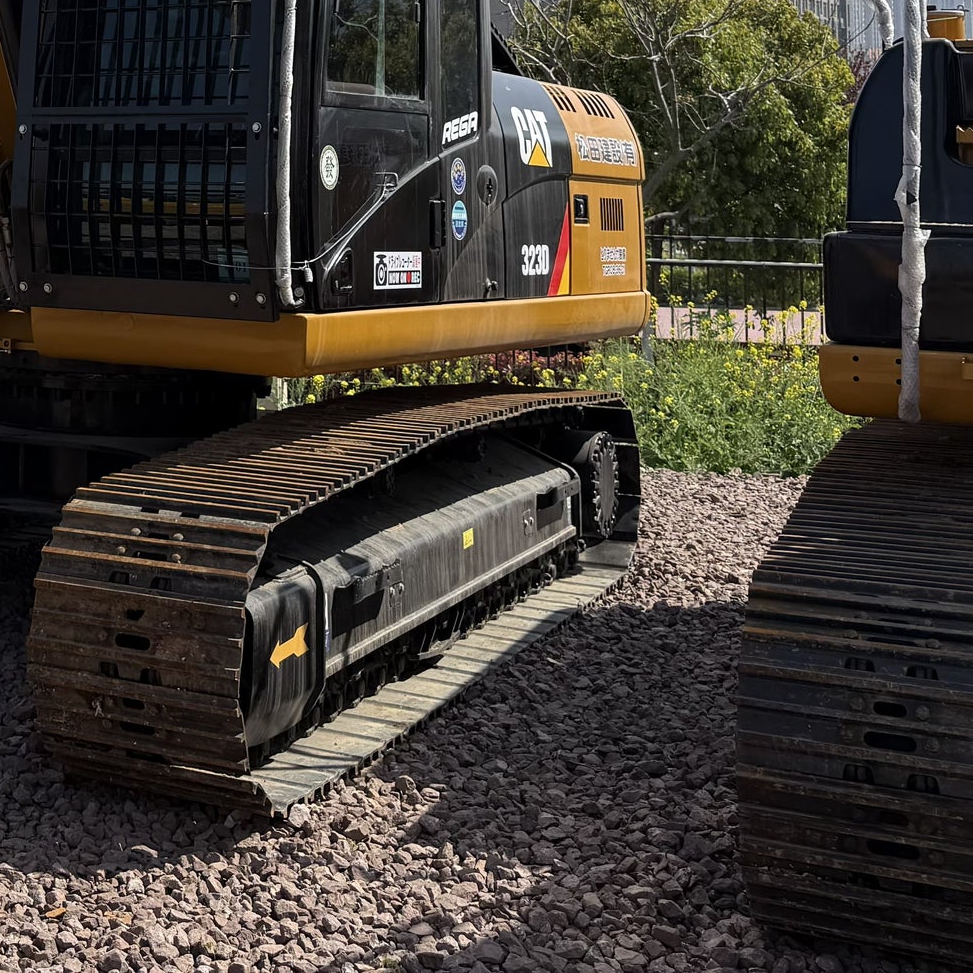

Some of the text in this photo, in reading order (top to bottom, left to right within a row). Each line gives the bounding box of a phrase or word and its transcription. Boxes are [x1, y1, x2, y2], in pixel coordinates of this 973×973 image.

[442, 111, 479, 145] REGA
[511, 106, 553, 168] CAT
[521, 244, 550, 276] 323D
